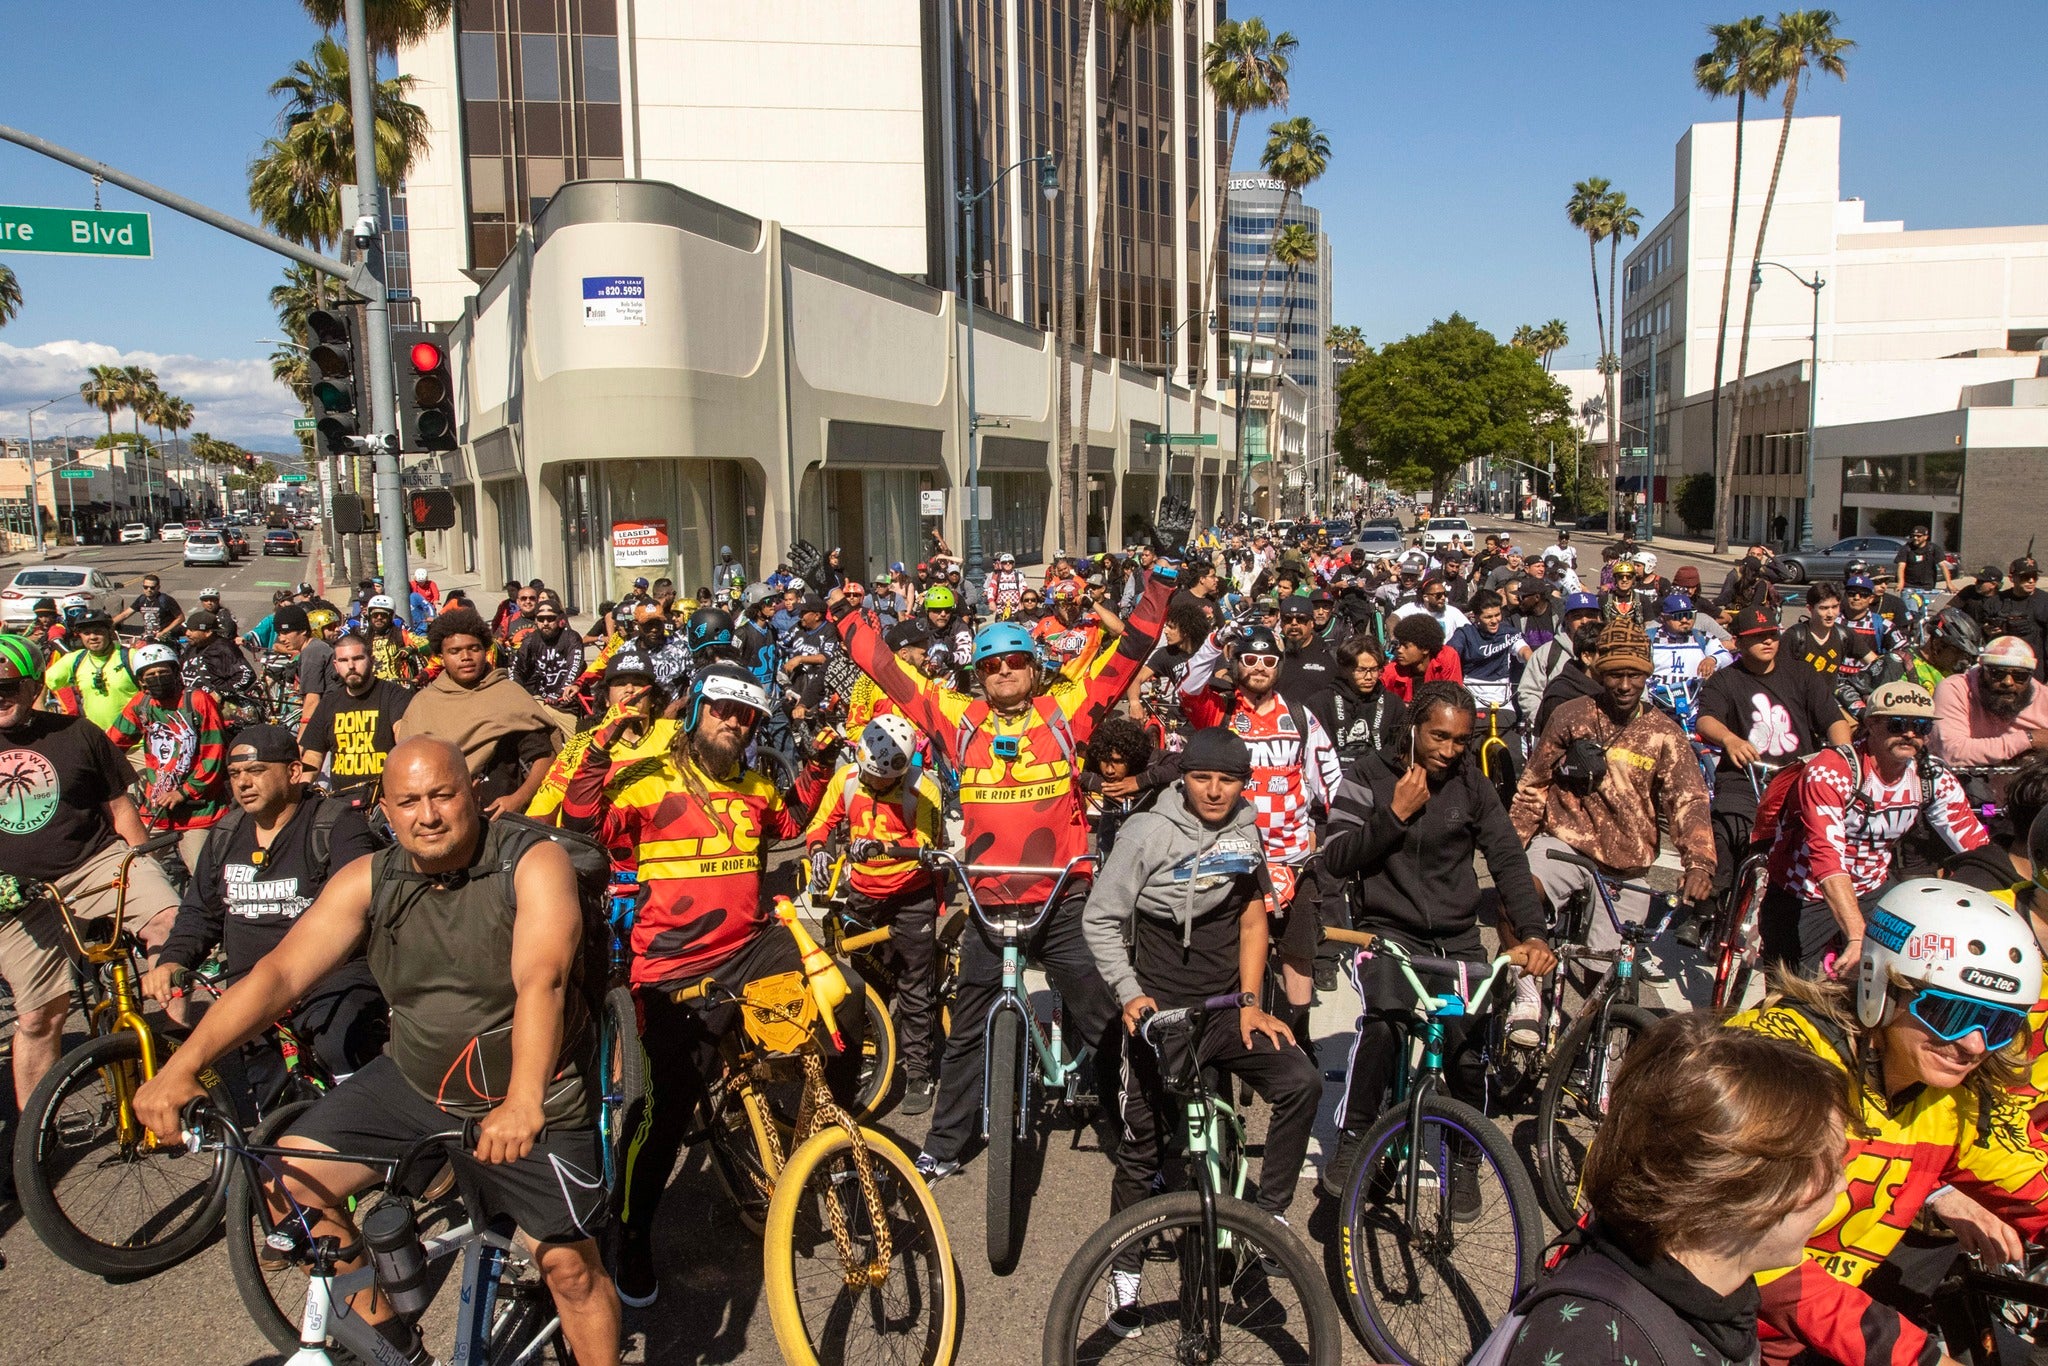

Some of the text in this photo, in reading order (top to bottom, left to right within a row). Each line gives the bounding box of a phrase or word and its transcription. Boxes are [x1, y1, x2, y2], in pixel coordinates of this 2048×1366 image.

[71, 220, 133, 246] Blvd
[605, 286, 642, 296] 820.5959
[402, 474, 433, 487] WILSHIRE
[618, 529, 650, 538] LEASED
[641, 537, 660, 545] 6585
[616, 548, 648, 557] Jay Luchs
[1755, 610, 1768, 623] LA
[1479, 632, 1522, 658] Yankees
[1671, 650, 1685, 674] LA
[1883, 690, 1932, 708] Cookies
[334, 710, 379, 734] DON'T
[335, 732, 376, 754] FUCK
[28, 754, 54, 788] WALL
[332, 752, 388, 776] AROUND
[33, 792, 51, 800] 1966
[975, 784, 1057, 800] WE RIDE AS ONE
[0, 800, 55, 831] RIGINAL
[224, 864, 257, 883] 4130
[699, 862, 718, 874] WE
[721, 858, 744, 872] RIDE
[227, 878, 298, 901] SUBWAY
[1907, 932, 1956, 961] USA
[1966, 969, 2016, 993] Pro-tec
[1110, 1217, 1159, 1251] SNAKESKIN
[1342, 1225, 1359, 1295] MAXXIS
[1824, 1254, 1858, 1279] AS
